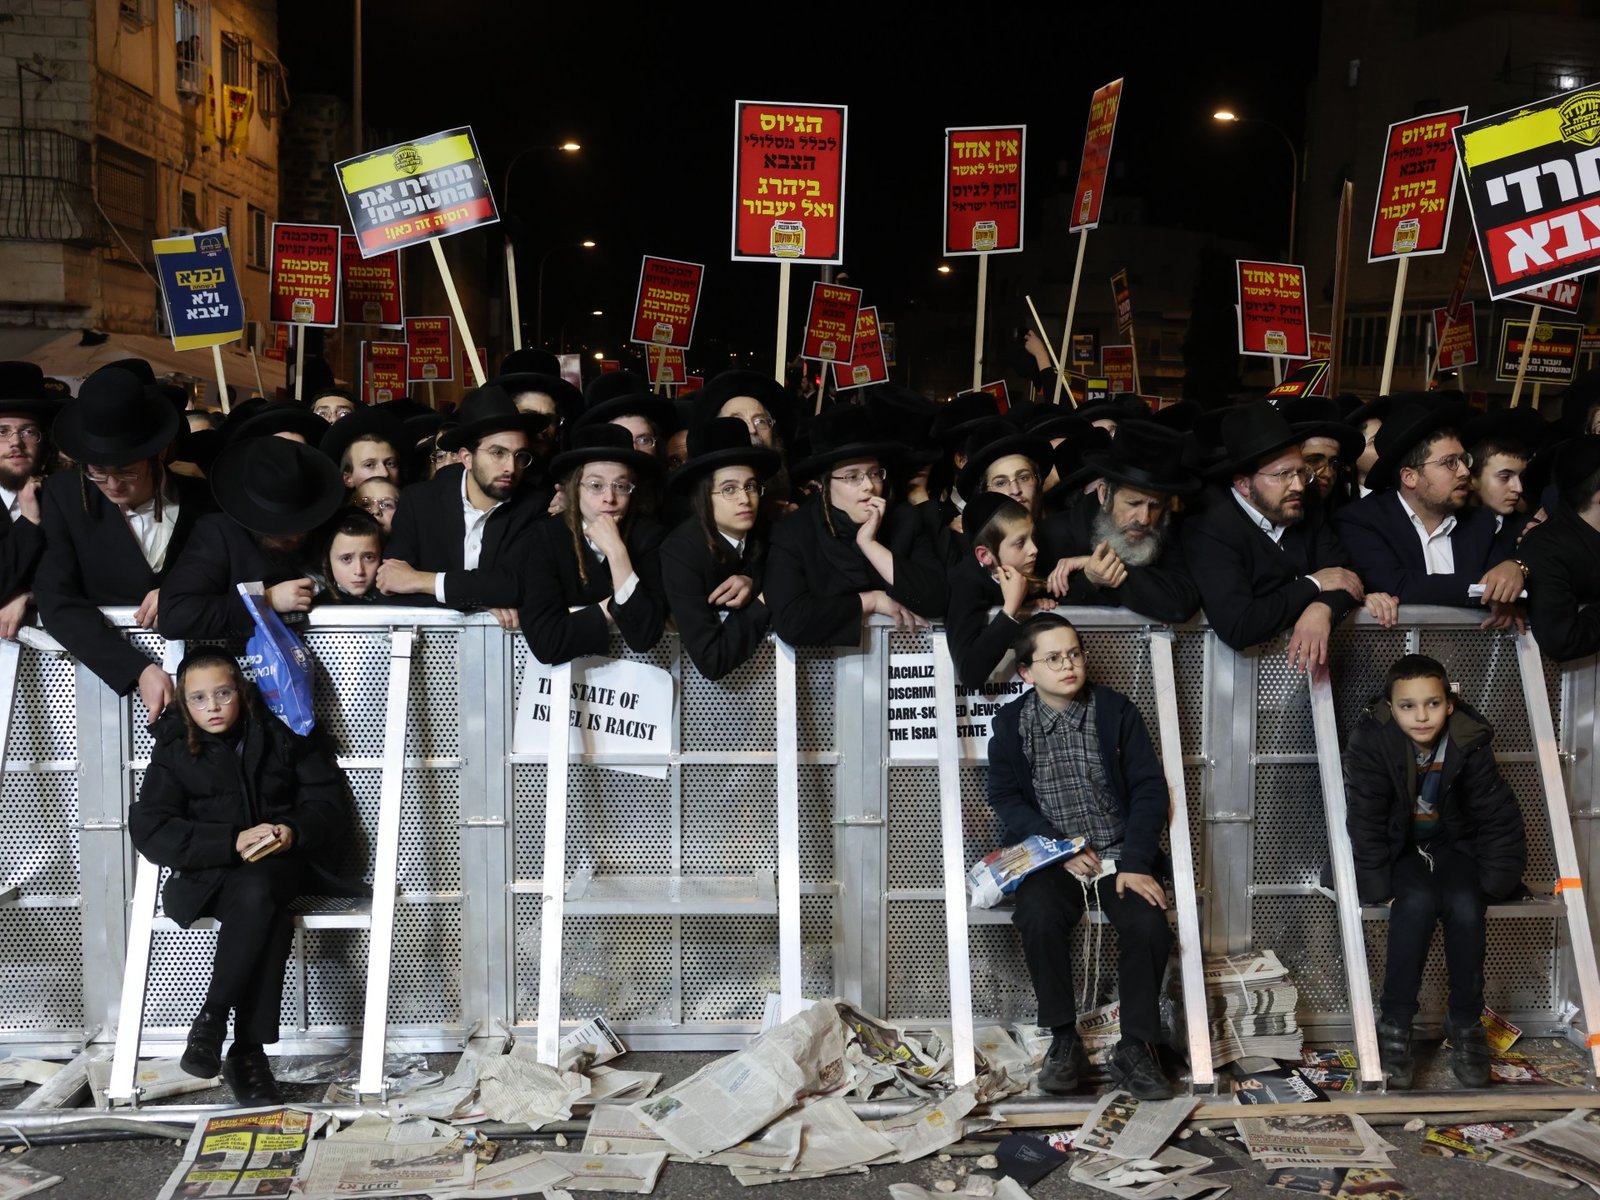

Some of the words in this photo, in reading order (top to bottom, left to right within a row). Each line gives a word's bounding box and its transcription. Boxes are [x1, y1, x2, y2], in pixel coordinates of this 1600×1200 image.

[759, 112, 823, 134] הגיוס
[744, 132, 796, 150] מסלולי
[1401, 122, 1447, 146] הגיוס
[799, 135, 837, 151] לכלל
[952, 140, 991, 159] אחד
[995, 139, 1018, 161] אין
[763, 153, 816, 171] הצבא
[952, 162, 986, 176] לאשר
[988, 162, 1018, 174] שיכול
[1399, 158, 1437, 177] הצבא
[398, 163, 474, 197] תחזירו
[757, 176, 821, 197] ביהרג
[952, 181, 989, 197] לגיוס
[993, 182, 1017, 199] חוק
[1391, 179, 1437, 201] ביהרג
[358, 185, 395, 210] את
[367, 182, 476, 225] החטופים!
[1419, 197, 1445, 214] ואל
[742, 198, 797, 217] יעבור
[800, 198, 835, 218] ואל
[952, 201, 987, 212] ישראל
[1380, 202, 1416, 220] יעבור
[415, 217, 431, 231] זה
[433, 207, 469, 227] רוסיה
[281, 230, 329, 243] הסכמה
[384, 222, 413, 241] כאן!
[277, 243, 305, 254] הגיוס
[308, 244, 334, 256] לחוק
[281, 257, 329, 272] הסכמה
[348, 266, 391, 278] הסכמה
[179, 268, 221, 284] לכלא
[277, 272, 332, 286] להחרבת
[1242, 269, 1275, 284] אחד
[1278, 271, 1300, 288] אין
[191, 290, 221, 306] ולא
[278, 285, 330, 298] היהדות
[647, 287, 690, 303] הסכמה
[823, 288, 852, 302] הגיוס
[1244, 286, 1271, 297] לאשר
[1273, 287, 1301, 299] שיכול
[1554, 283, 1577, 305] או
[186, 303, 229, 320] לצבא
[642, 298, 691, 315] להחרבת
[1279, 303, 1301, 316] חוק
[641, 309, 687, 325] היהדות
[414, 321, 442, 330] הגיוס
[817, 319, 846, 332] ביהרג
[810, 328, 835, 340] יעבור
[836, 332, 851, 343] ואל
[371, 345, 399, 356] הגיוס
[888, 665, 935, 680] RACIALIZ
[570, 682, 616, 706] STATE
[619, 691, 640, 710] OF
[888, 704, 968, 721] DARK-SKED
[970, 702, 1001, 717] JEWS
[532, 703, 583, 729] ISEL
[587, 713, 602, 731] IS
[604, 716, 658, 741] RACIST
[888, 728, 909, 741] THE
[956, 723, 987, 738] STATE
